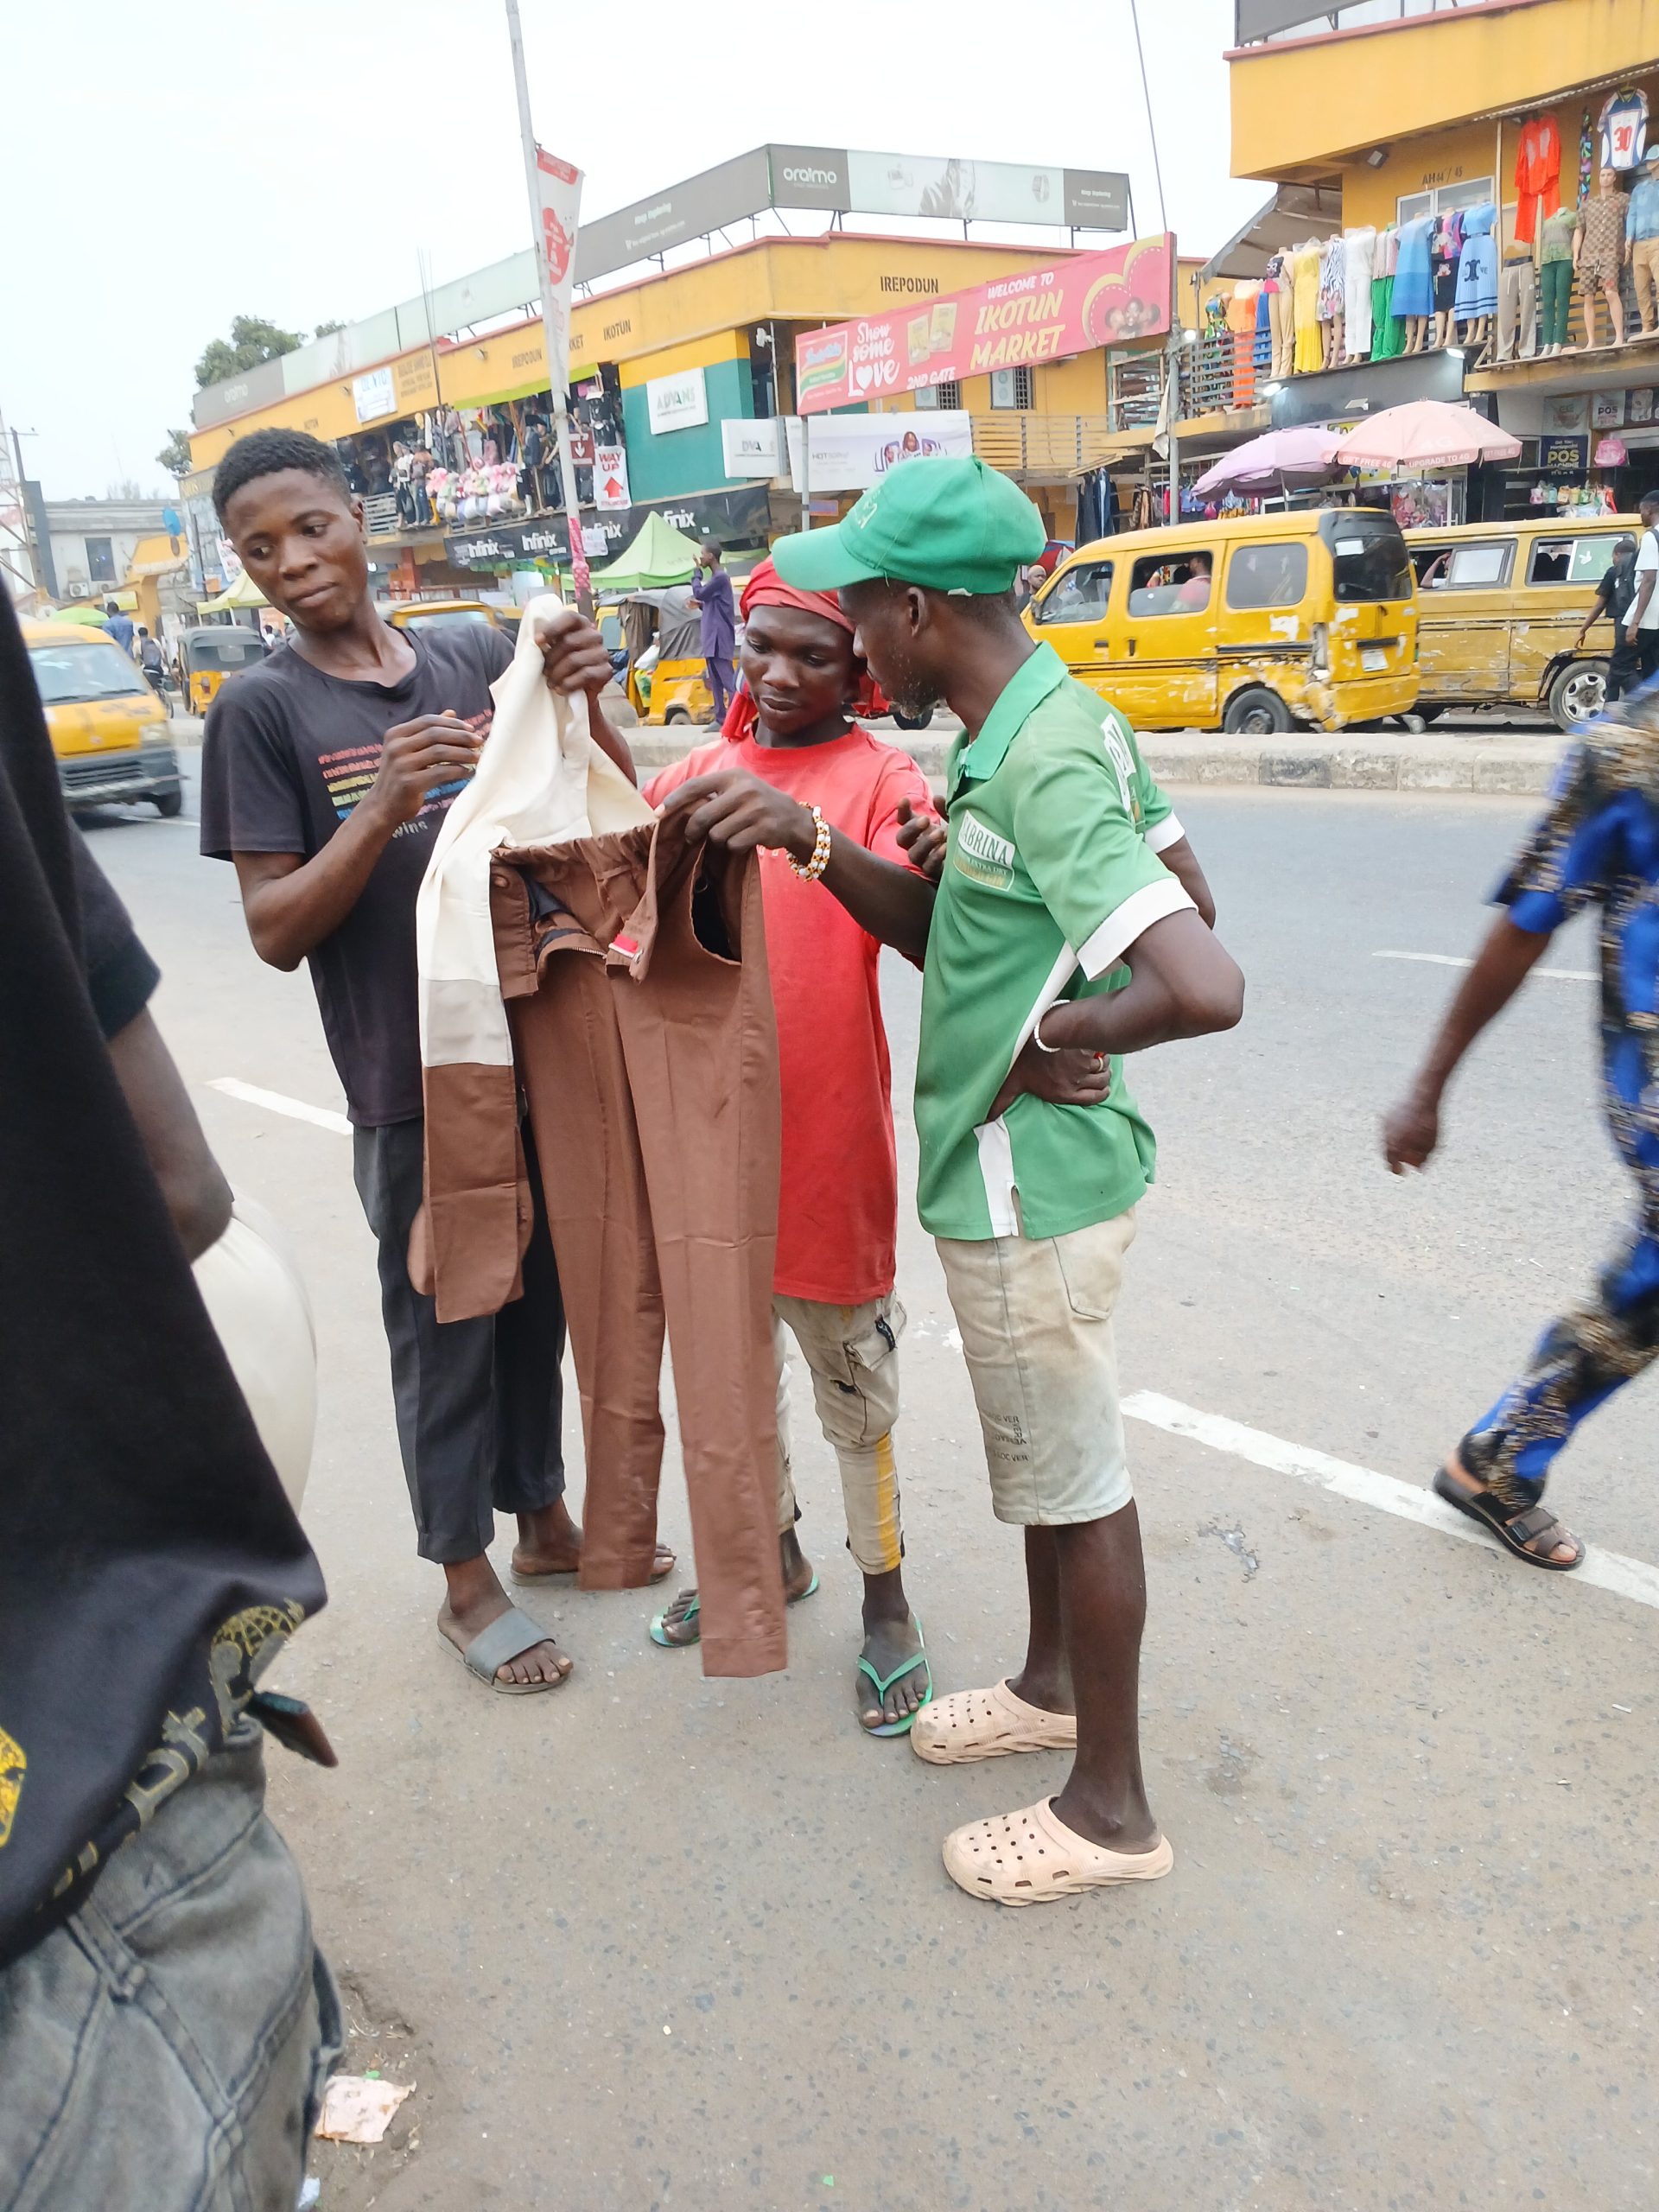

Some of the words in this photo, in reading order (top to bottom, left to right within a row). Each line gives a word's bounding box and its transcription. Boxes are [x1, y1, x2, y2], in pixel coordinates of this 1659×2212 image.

[783, 167, 837, 184] oraimo
[880, 276, 939, 294] IREPODUN
[987, 276, 1037, 300] WELCOME
[1040, 271, 1054, 287] TO
[974, 289, 1064, 335] IKOTUN
[603, 319, 632, 341] IKOTUN
[857, 321, 893, 344] Show
[969, 323, 1066, 372] MARKET
[928, 366, 957, 385] GATE
[1598, 405, 1618, 416] POS
[598, 452, 621, 463] WAY
[1359, 457, 1382, 467] FREE
[1408, 456, 1446, 468] UPGRADE
[1446, 454, 1459, 462] TO
[1547, 449, 1580, 464] POS
[602, 462, 620, 472] UP
[522, 530, 557, 551] Infinix
